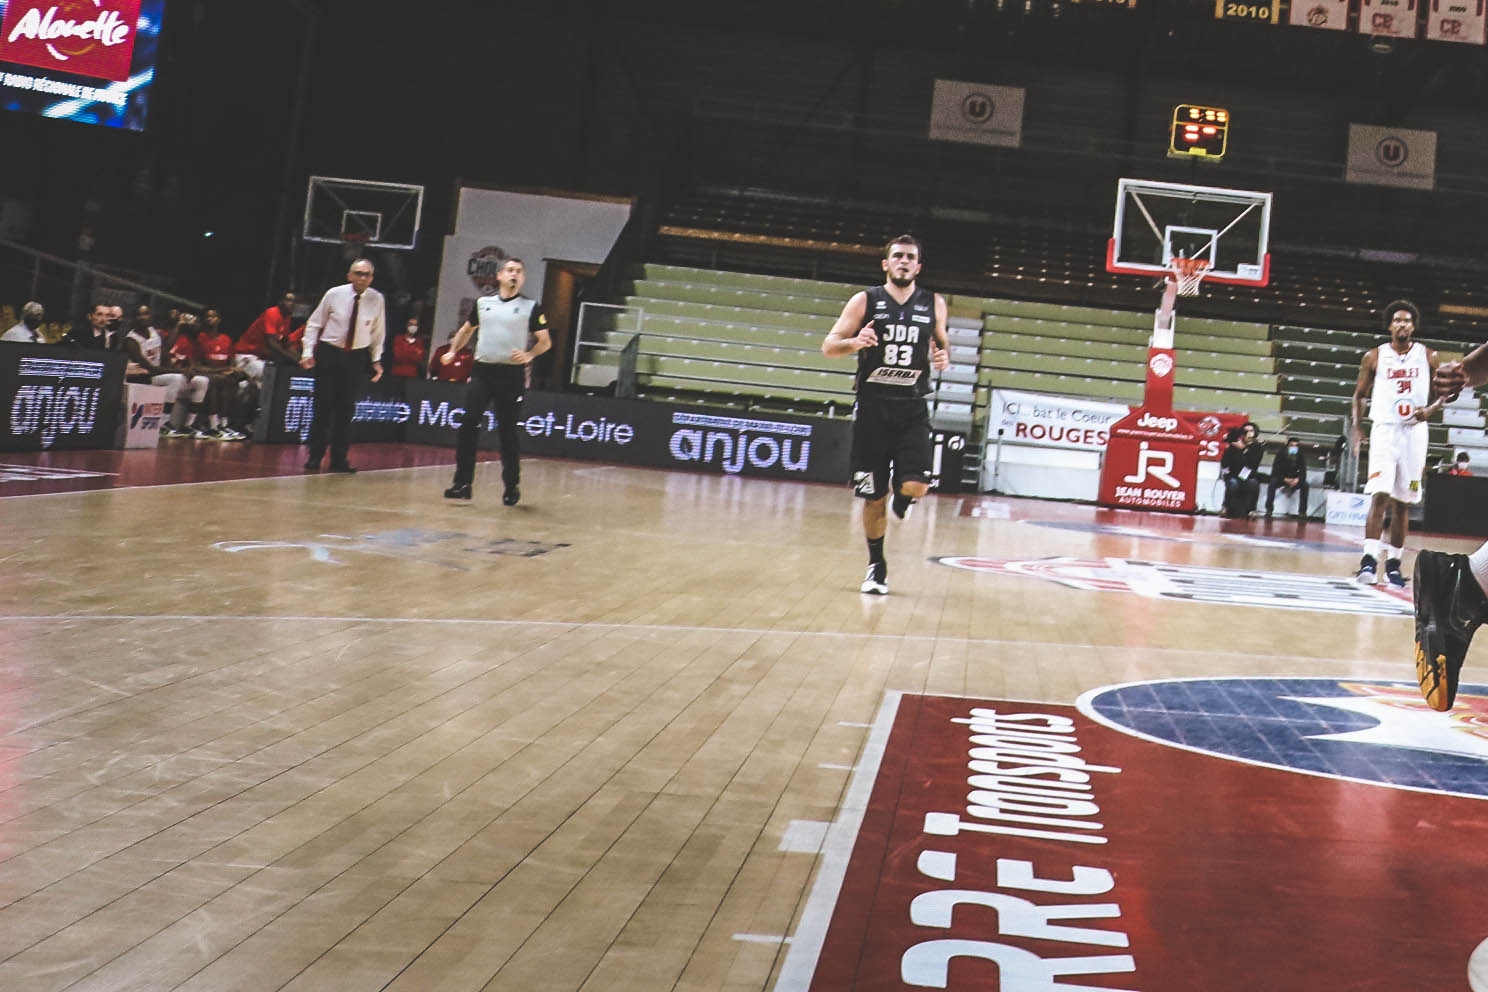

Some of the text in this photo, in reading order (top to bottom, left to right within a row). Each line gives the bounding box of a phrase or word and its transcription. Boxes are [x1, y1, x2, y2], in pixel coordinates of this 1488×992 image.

[1227, 2, 1269, 19] 2010
[8, 6, 130, 47] Alouette
[881, 324, 920, 344] JDA
[882, 344, 913, 366] 83
[877, 366, 915, 380] ISERBA
[9, 384, 102, 450] anjou
[1032, 406, 1054, 421] bat
[1056, 406, 1068, 421] le
[1069, 409, 1113, 426] Coeur
[1136, 412, 1178, 433] Jeep
[1014, 421, 1109, 447] ROUGES
[670, 428, 811, 474] anjou
[1114, 485, 1187, 501] JEAN ROUYER
[1117, 495, 1182, 508] AUTOMOBILES
[924, 708, 1122, 844] Transports
